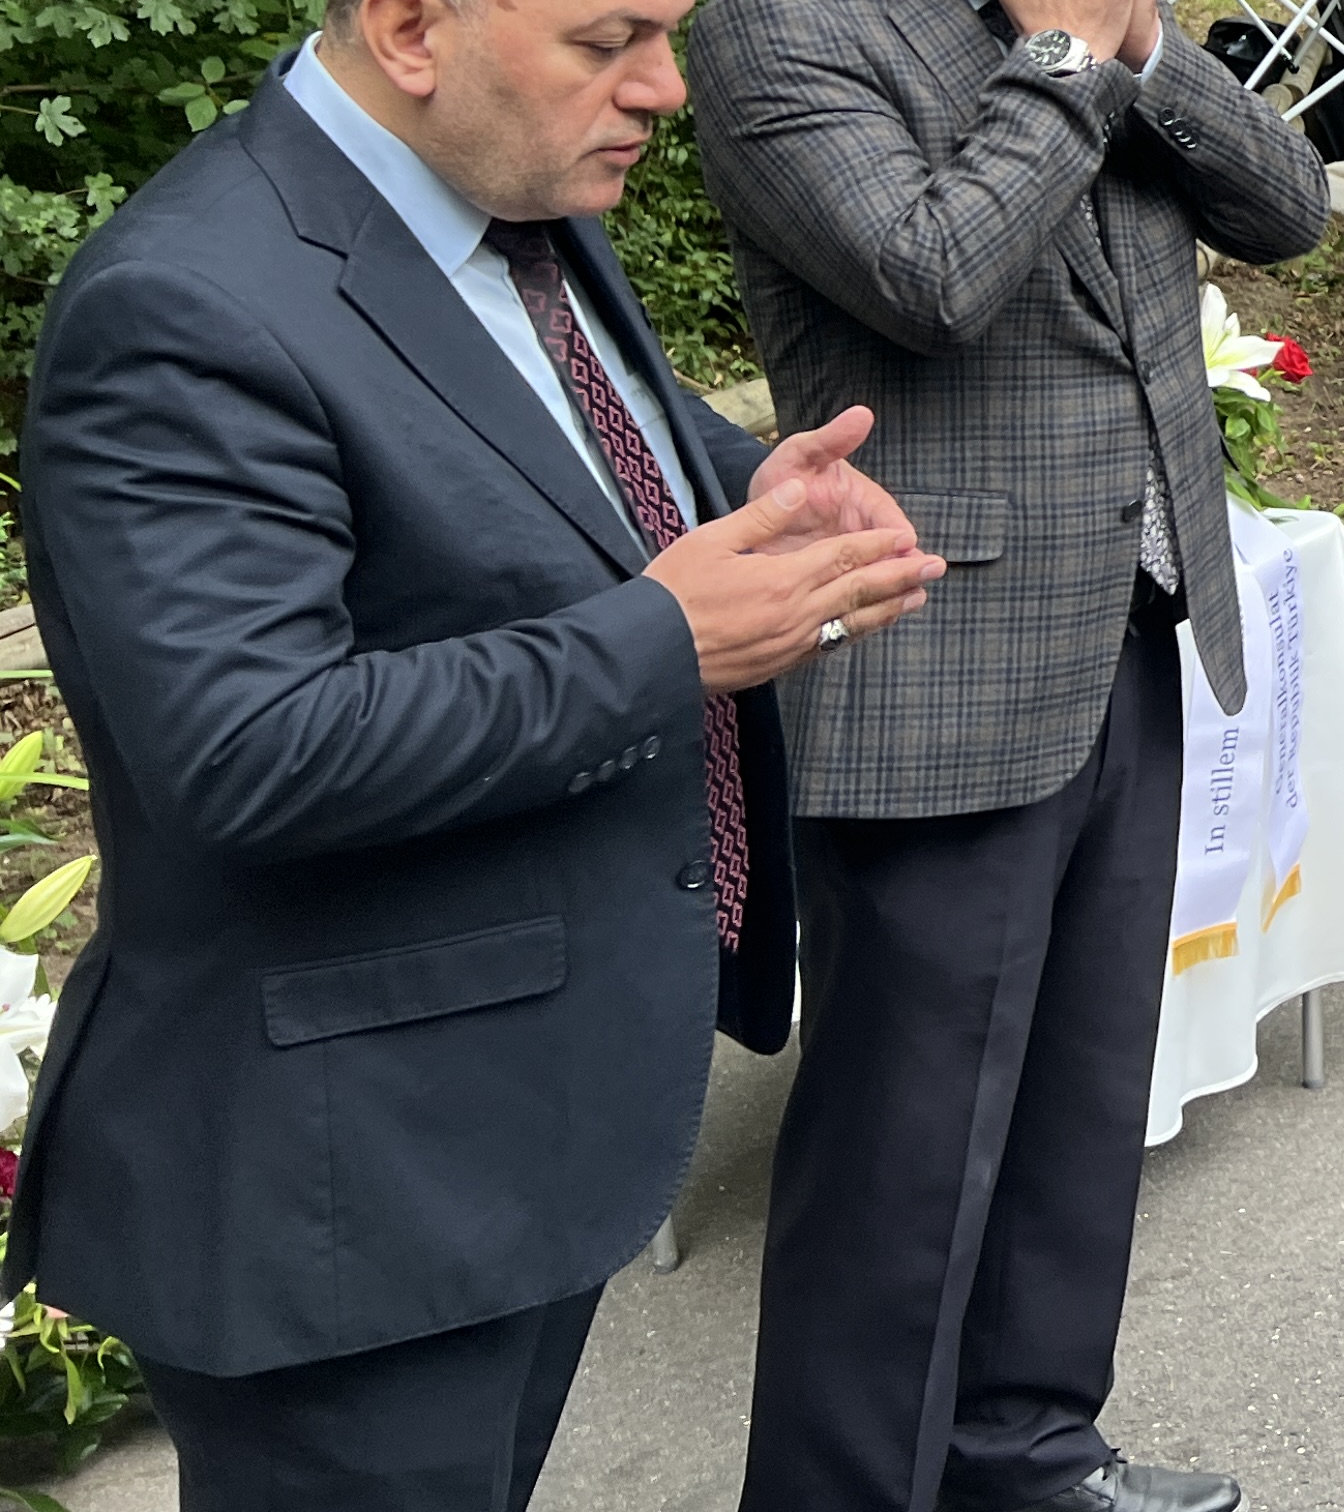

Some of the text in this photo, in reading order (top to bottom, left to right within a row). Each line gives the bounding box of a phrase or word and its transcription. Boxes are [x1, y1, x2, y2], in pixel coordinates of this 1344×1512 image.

[1282, 547, 1299, 650] Türkiye
[1268, 590, 1288, 795] Generalkonsulat
[1205, 727, 1240, 856] In stillem
[1286, 768, 1298, 809] der
